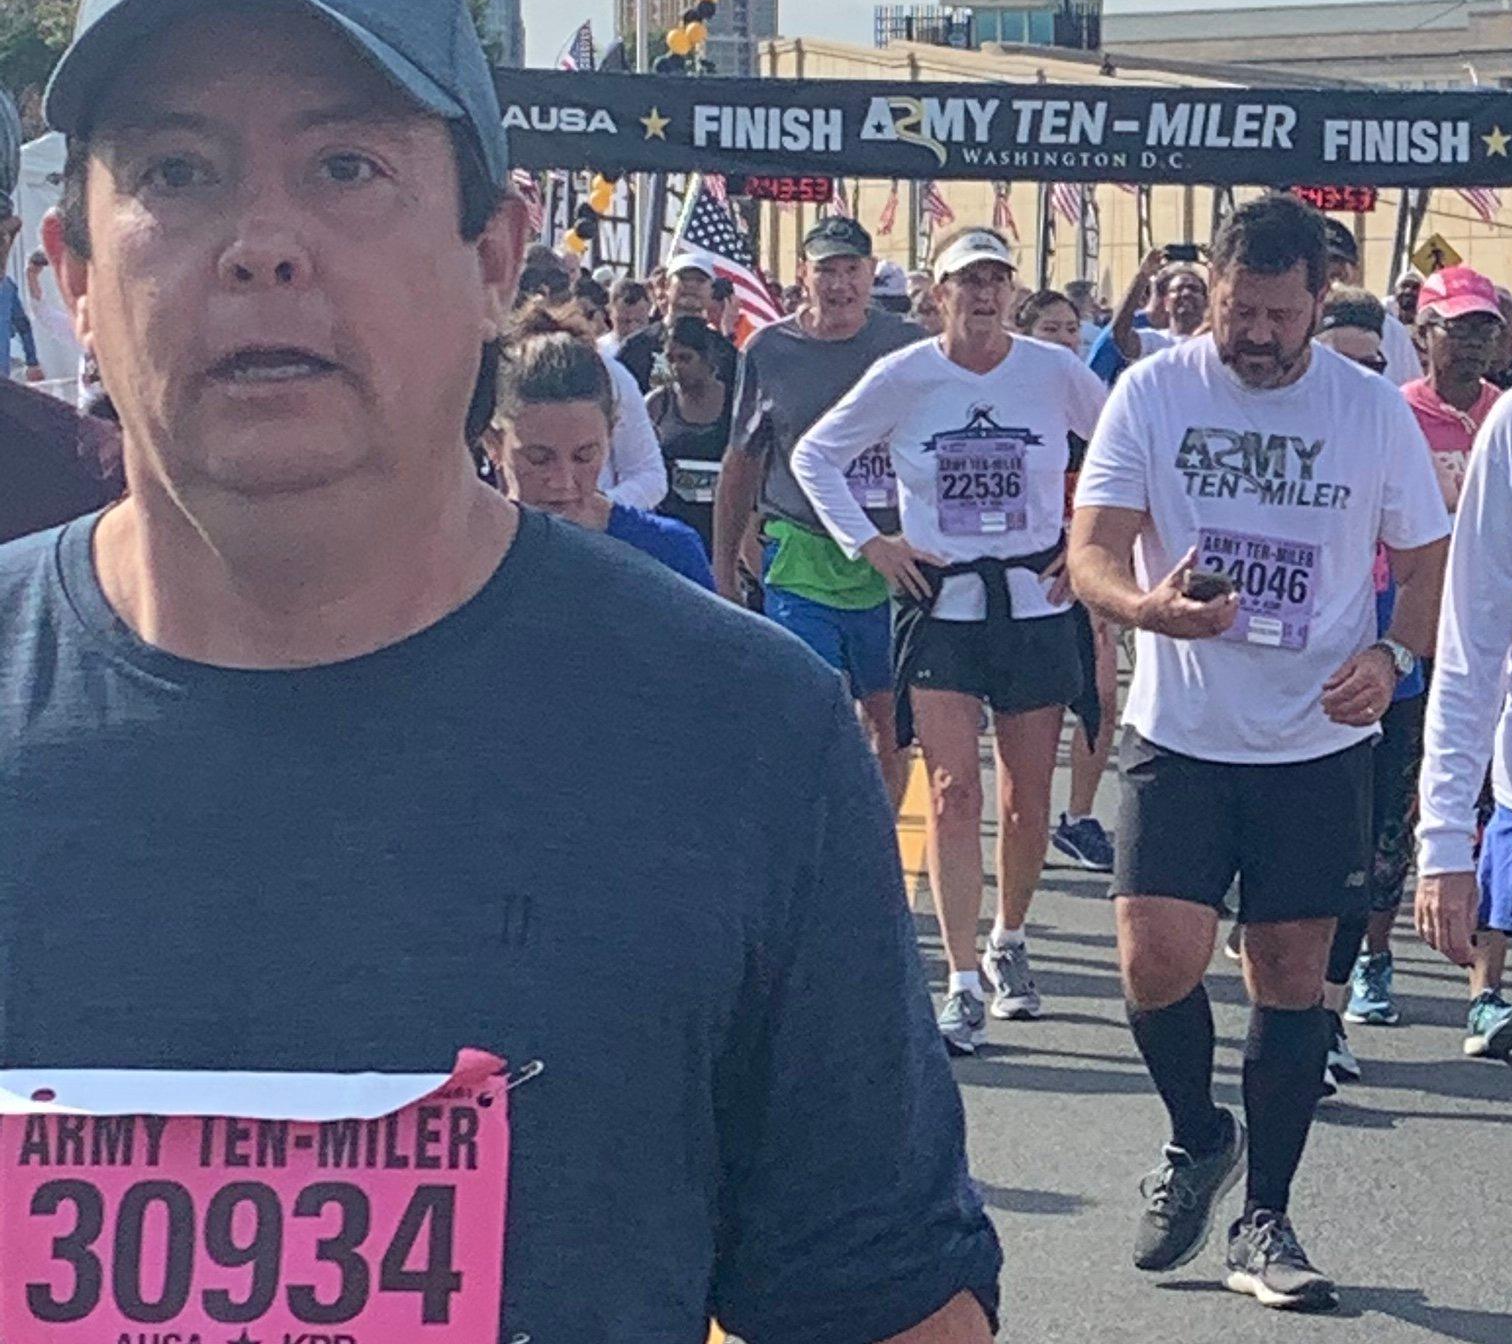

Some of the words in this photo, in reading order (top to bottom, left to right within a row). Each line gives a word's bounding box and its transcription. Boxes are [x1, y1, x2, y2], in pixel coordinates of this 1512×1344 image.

[501, 105, 619, 134] AUSA
[693, 106, 843, 152] FINISH
[860, 96, 1000, 167] ARMY
[1323, 119, 1471, 163] FINISH
[963, 148, 1128, 169] WASHINGTON
[1175, 426, 1326, 480] ARMY
[942, 472, 1021, 501] 22536
[1183, 471, 1351, 509] TEN-MILER
[18, 1113, 170, 1167] ARMY
[199, 1106, 479, 1170] TEN-MILER
[25, 1177, 463, 1324] 30934
